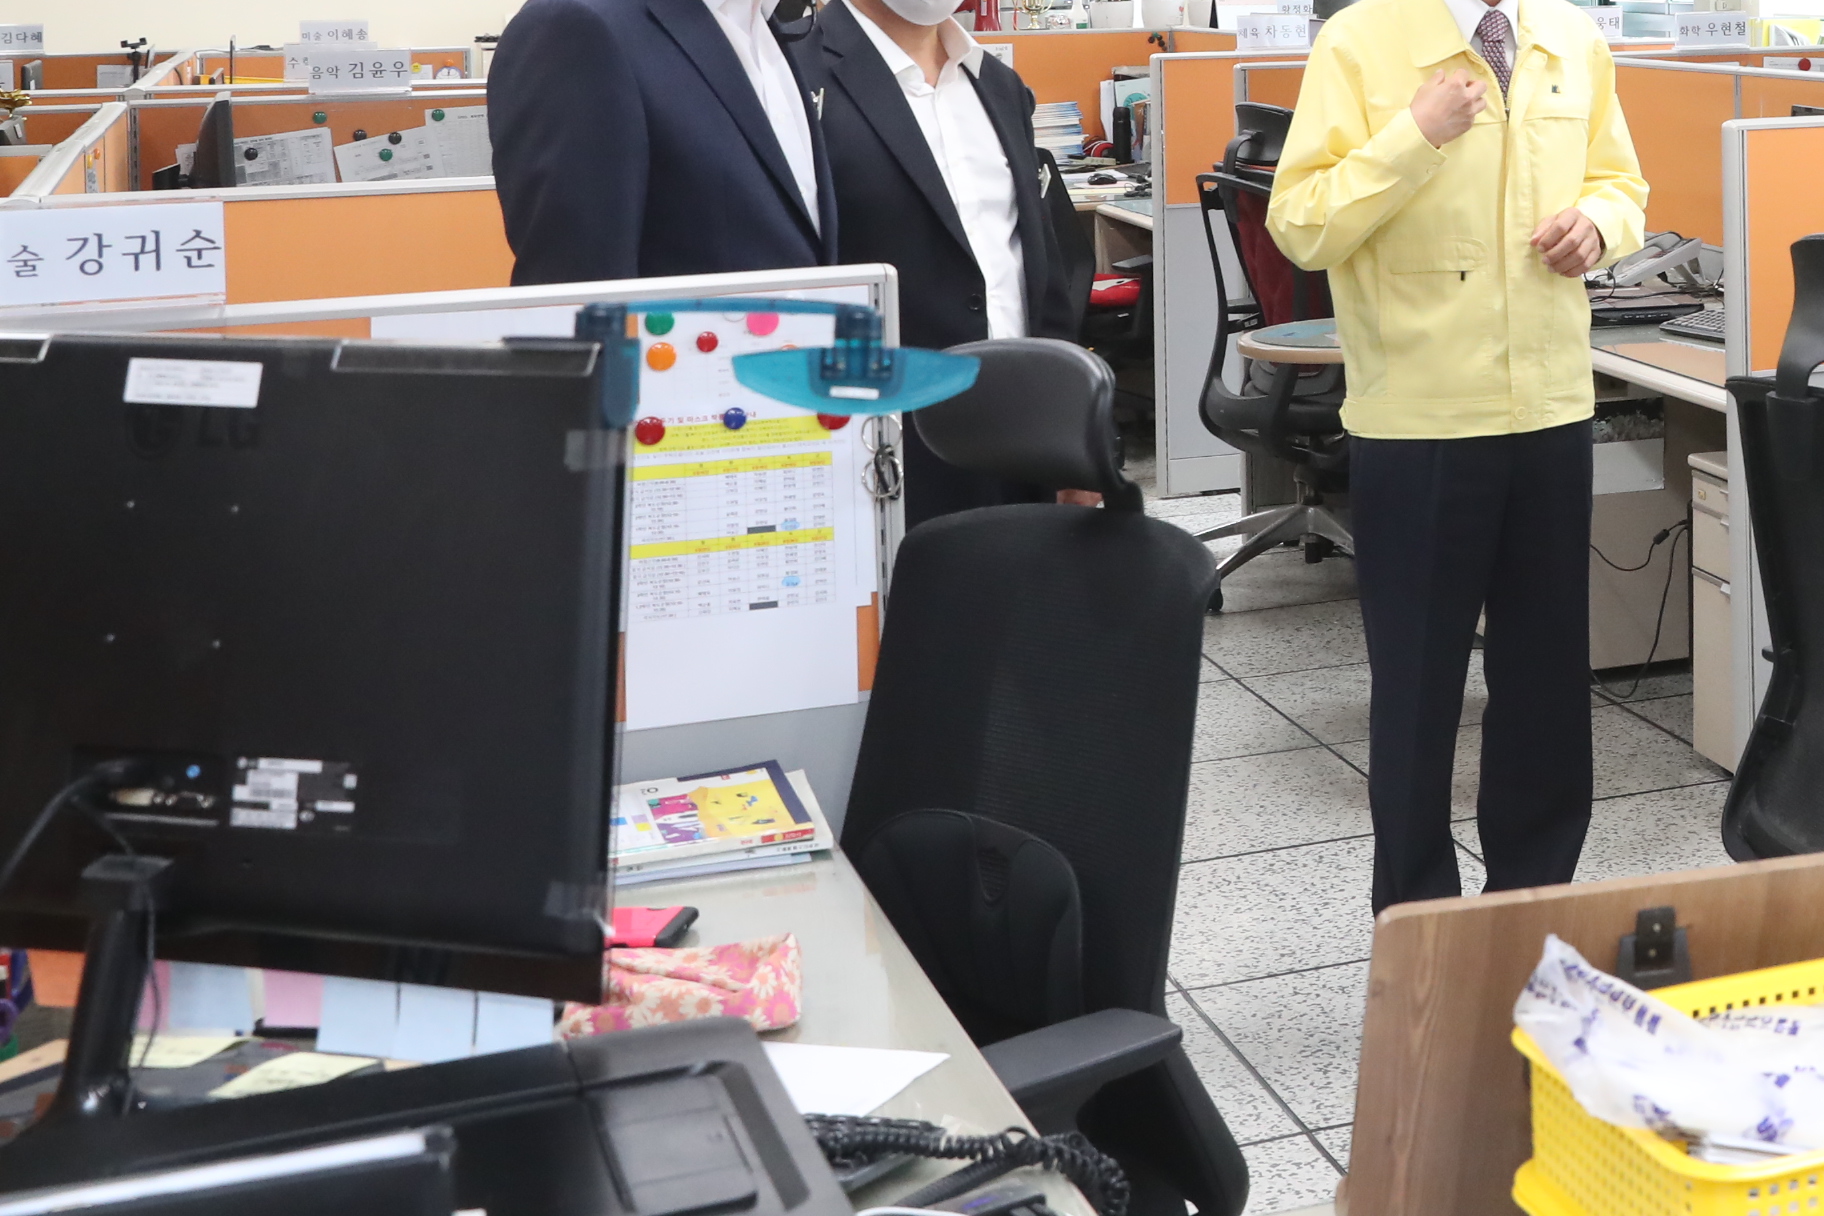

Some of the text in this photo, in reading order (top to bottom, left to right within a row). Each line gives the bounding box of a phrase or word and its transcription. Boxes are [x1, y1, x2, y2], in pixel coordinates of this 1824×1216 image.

[301, 28, 368, 41] 미술 이혜송
[1264, 24, 1307, 39] 차동현
[1679, 21, 1746, 37] 화학 우현철
[1, 31, 43, 44] 김다혜
[309, 60, 409, 80] 음악 김윤우
[65, 228, 223, 277] 강귀순
